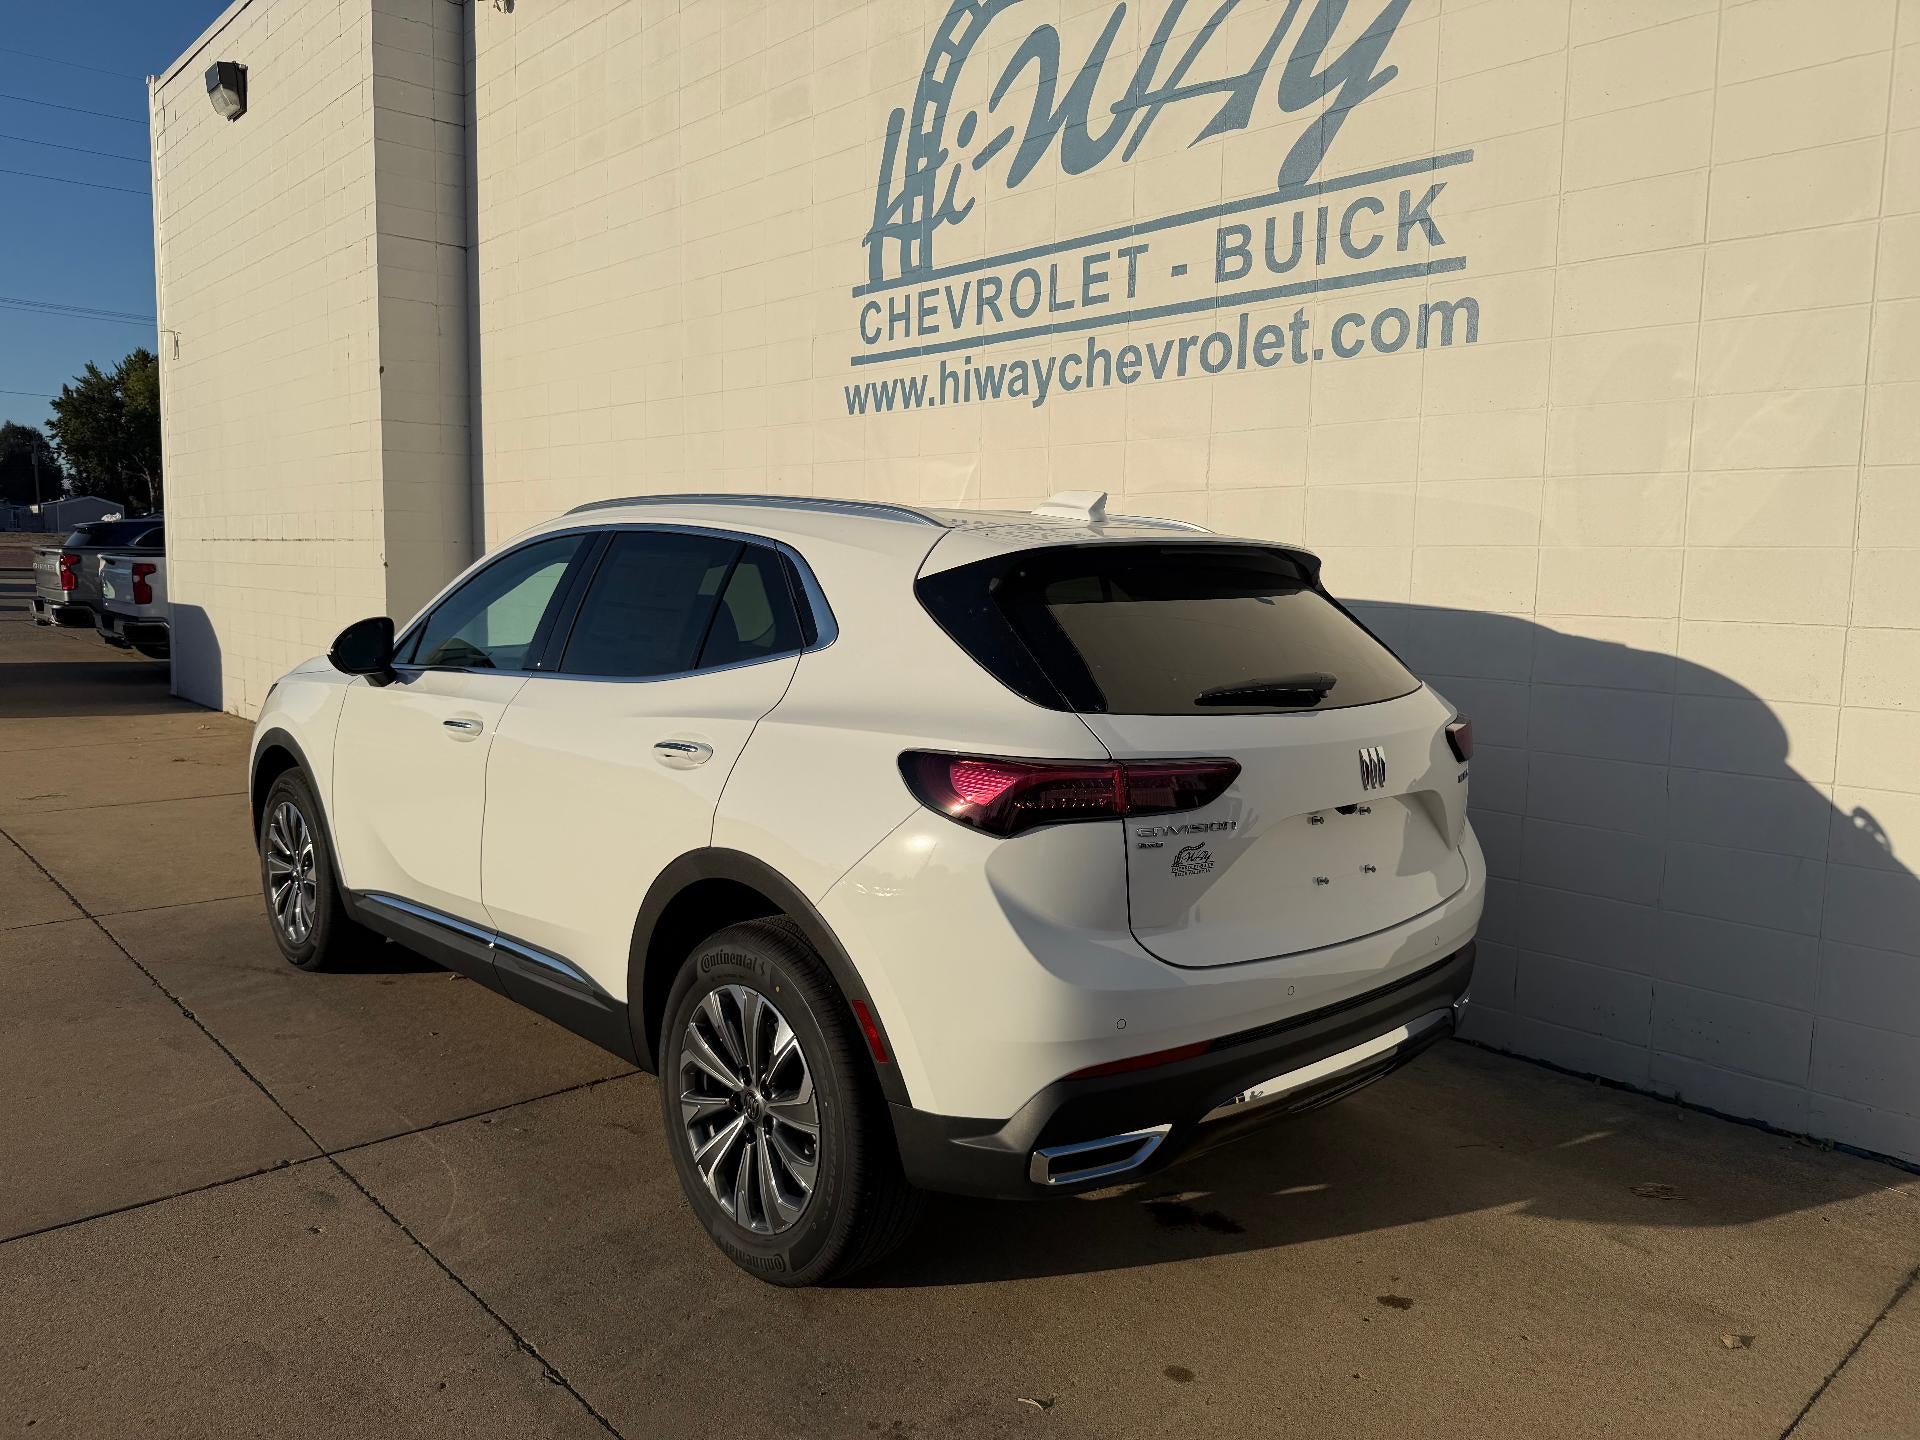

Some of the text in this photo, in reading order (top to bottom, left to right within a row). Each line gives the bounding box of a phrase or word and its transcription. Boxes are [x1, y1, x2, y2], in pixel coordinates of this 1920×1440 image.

[859, 244, 1149, 345] CHEVROLET
[1215, 182, 1447, 283] BUICK
[844, 297, 1479, 415] www.hiwaychevrolet.com
[701, 948, 758, 973] Continental
